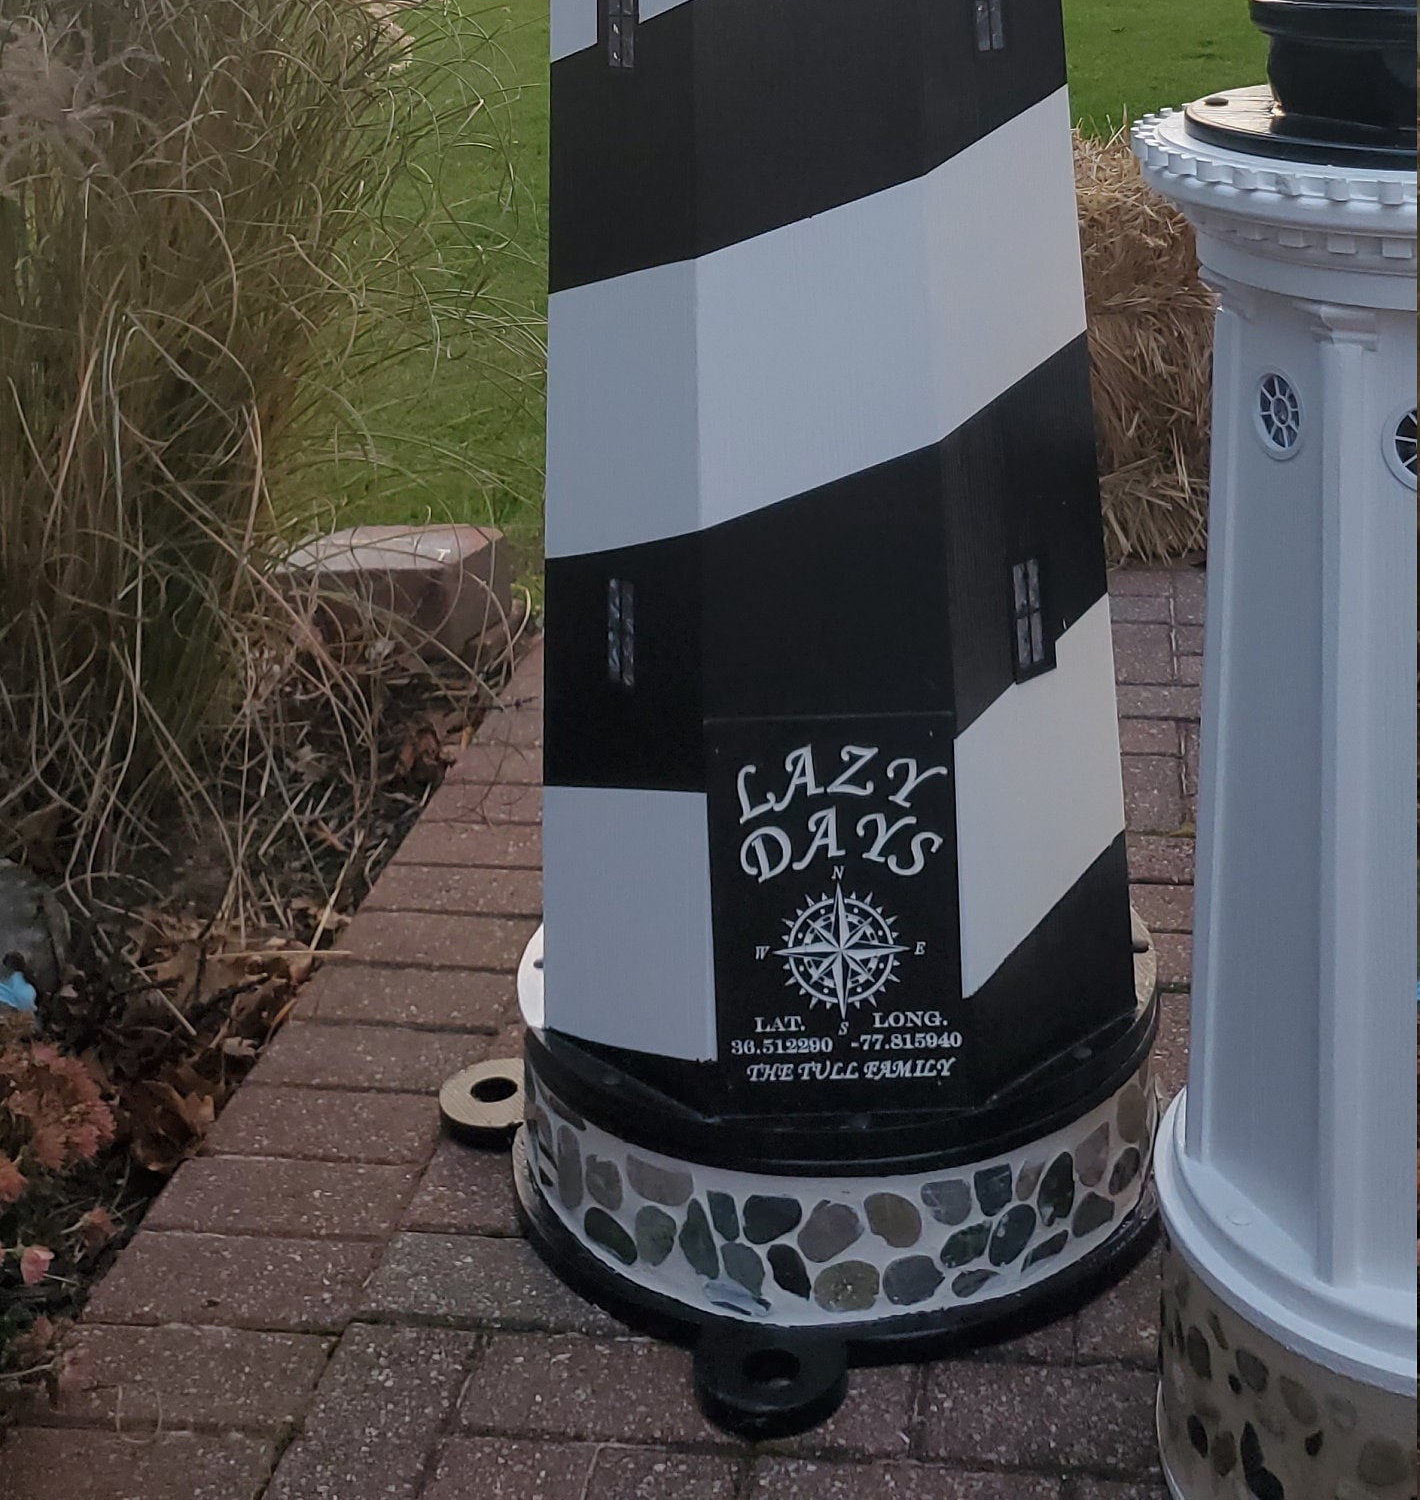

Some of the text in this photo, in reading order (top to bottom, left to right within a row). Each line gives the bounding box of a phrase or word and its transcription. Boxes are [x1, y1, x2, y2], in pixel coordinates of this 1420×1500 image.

[737, 744, 948, 825] LAZY
[740, 805, 943, 884] DAYS
[831, 865, 844, 880] N
[755, 946, 770, 960] W
[914, 941, 926, 956] E
[754, 1016, 806, 1033] LAT.
[838, 1020, 849, 1036] S
[872, 1011, 948, 1029] LONG.
[731, 1038, 833, 1055] 36.512290
[850, 1031, 963, 1051] -77.815940
[746, 1056, 956, 1082] THE TULL FAMILY
